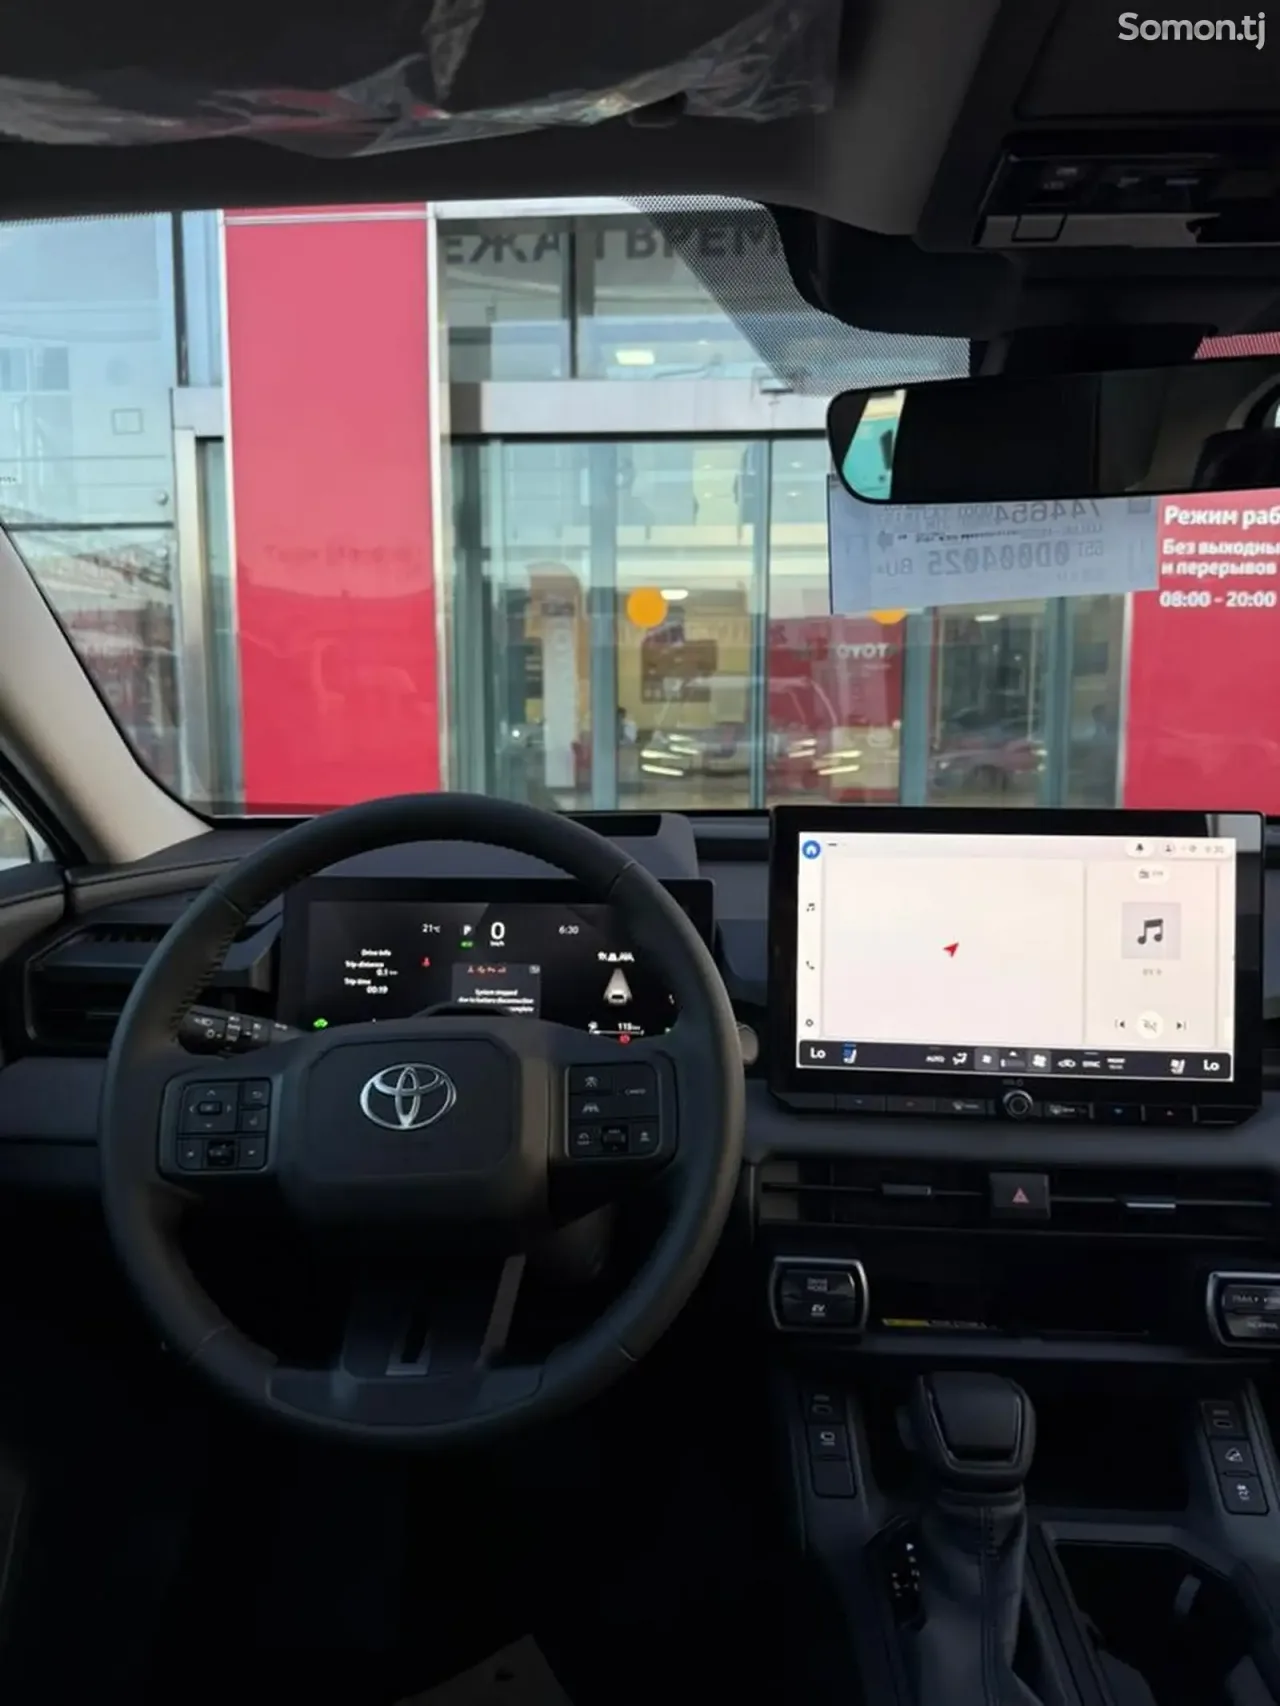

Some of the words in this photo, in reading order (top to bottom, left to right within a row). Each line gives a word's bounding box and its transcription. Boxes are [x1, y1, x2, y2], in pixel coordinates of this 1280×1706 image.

[1164, 505, 1239, 525] Режим
[1163, 538, 1196, 555] Без
[1161, 562, 1174, 575] и
[1160, 590, 1212, 607] 08:00
[1225, 590, 1277, 607] 20:00
[463, 925, 472, 936] P
[490, 921, 506, 940] 0
